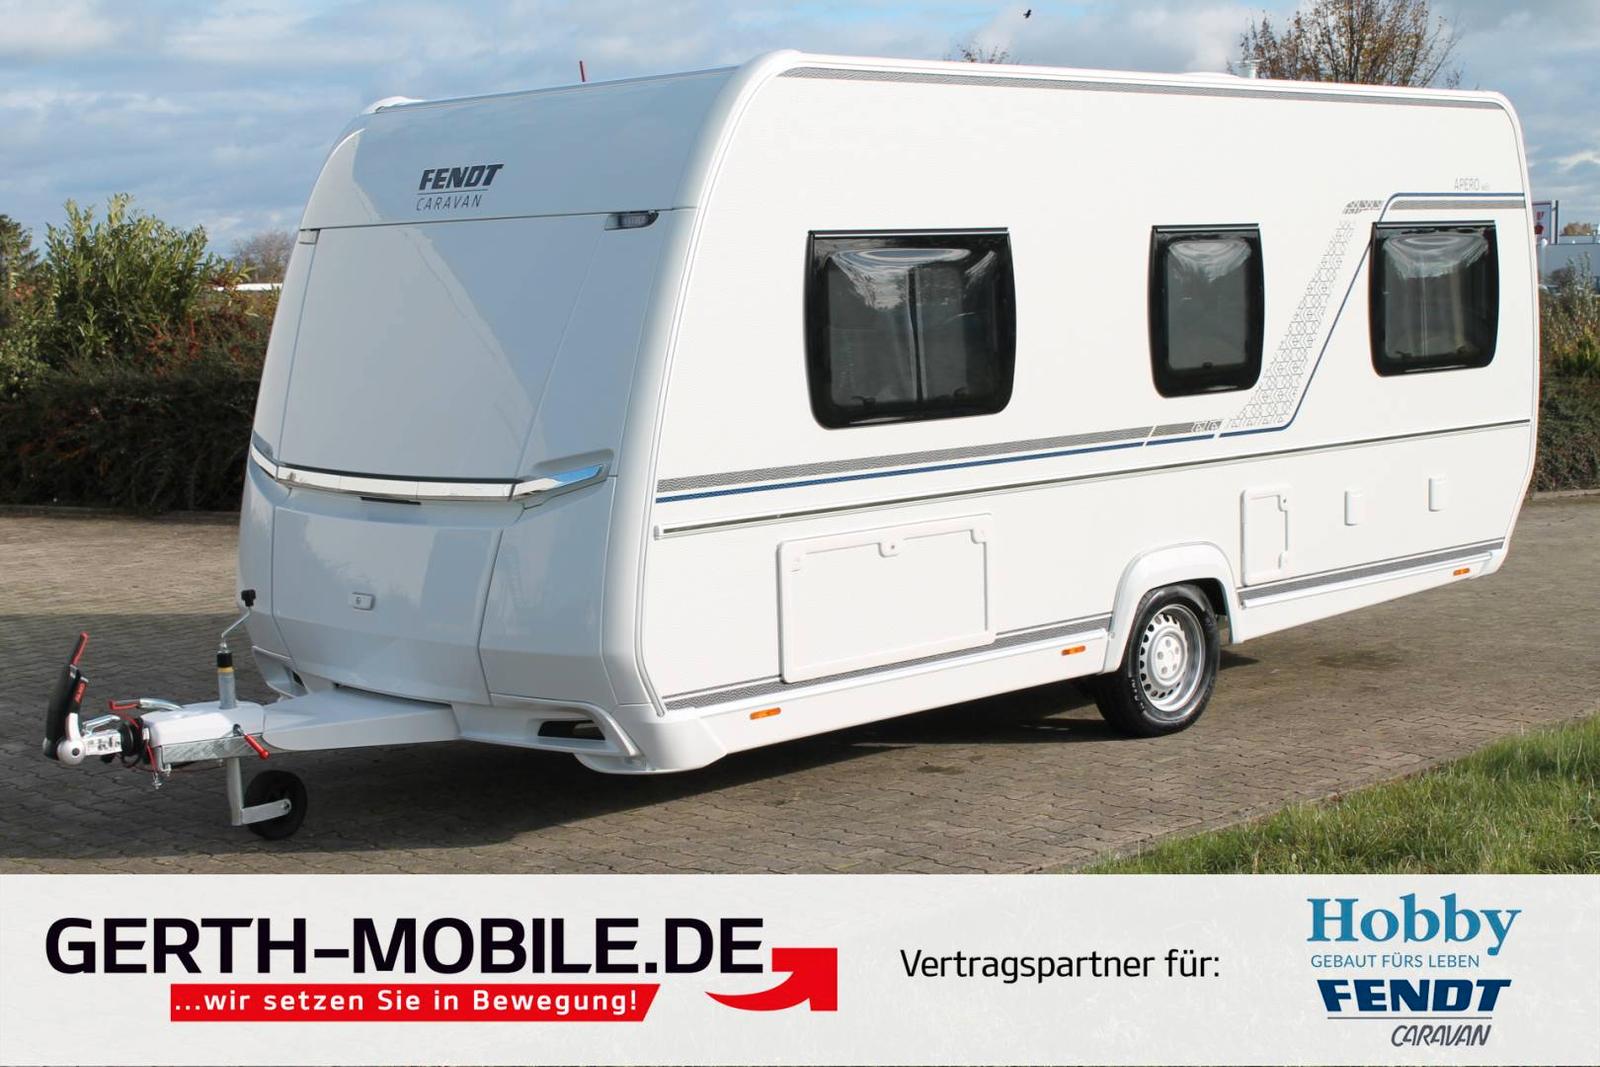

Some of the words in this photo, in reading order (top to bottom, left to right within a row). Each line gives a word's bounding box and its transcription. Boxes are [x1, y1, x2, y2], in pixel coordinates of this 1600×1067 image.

[418, 163, 504, 191] FENDT
[1454, 177, 1480, 191] APERO
[415, 194, 483, 212] CARAVAN
